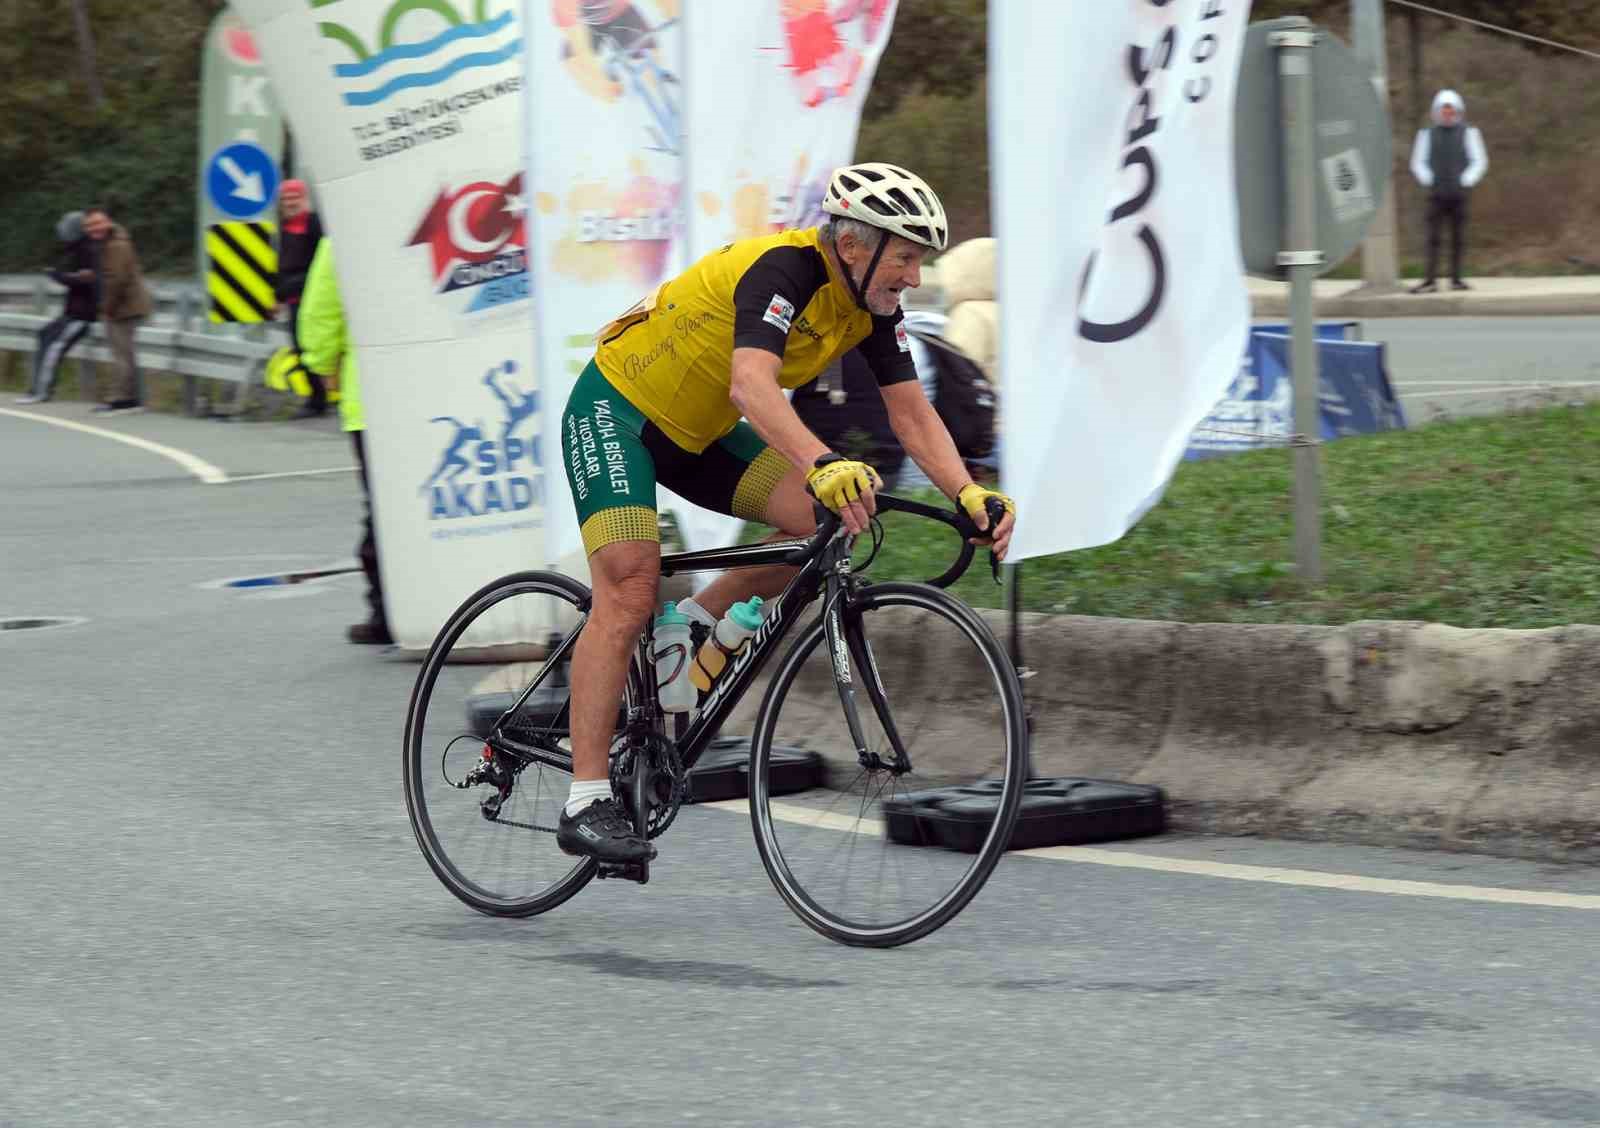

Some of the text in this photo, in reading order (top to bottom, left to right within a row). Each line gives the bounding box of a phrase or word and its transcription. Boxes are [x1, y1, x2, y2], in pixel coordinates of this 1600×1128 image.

[623, 311, 715, 381] Racing Team
[566, 413, 589, 500] SPOR KULÜBÜ
[578, 416, 601, 479] YILDIZLARI
[602, 440, 630, 495] BİSİKLET
